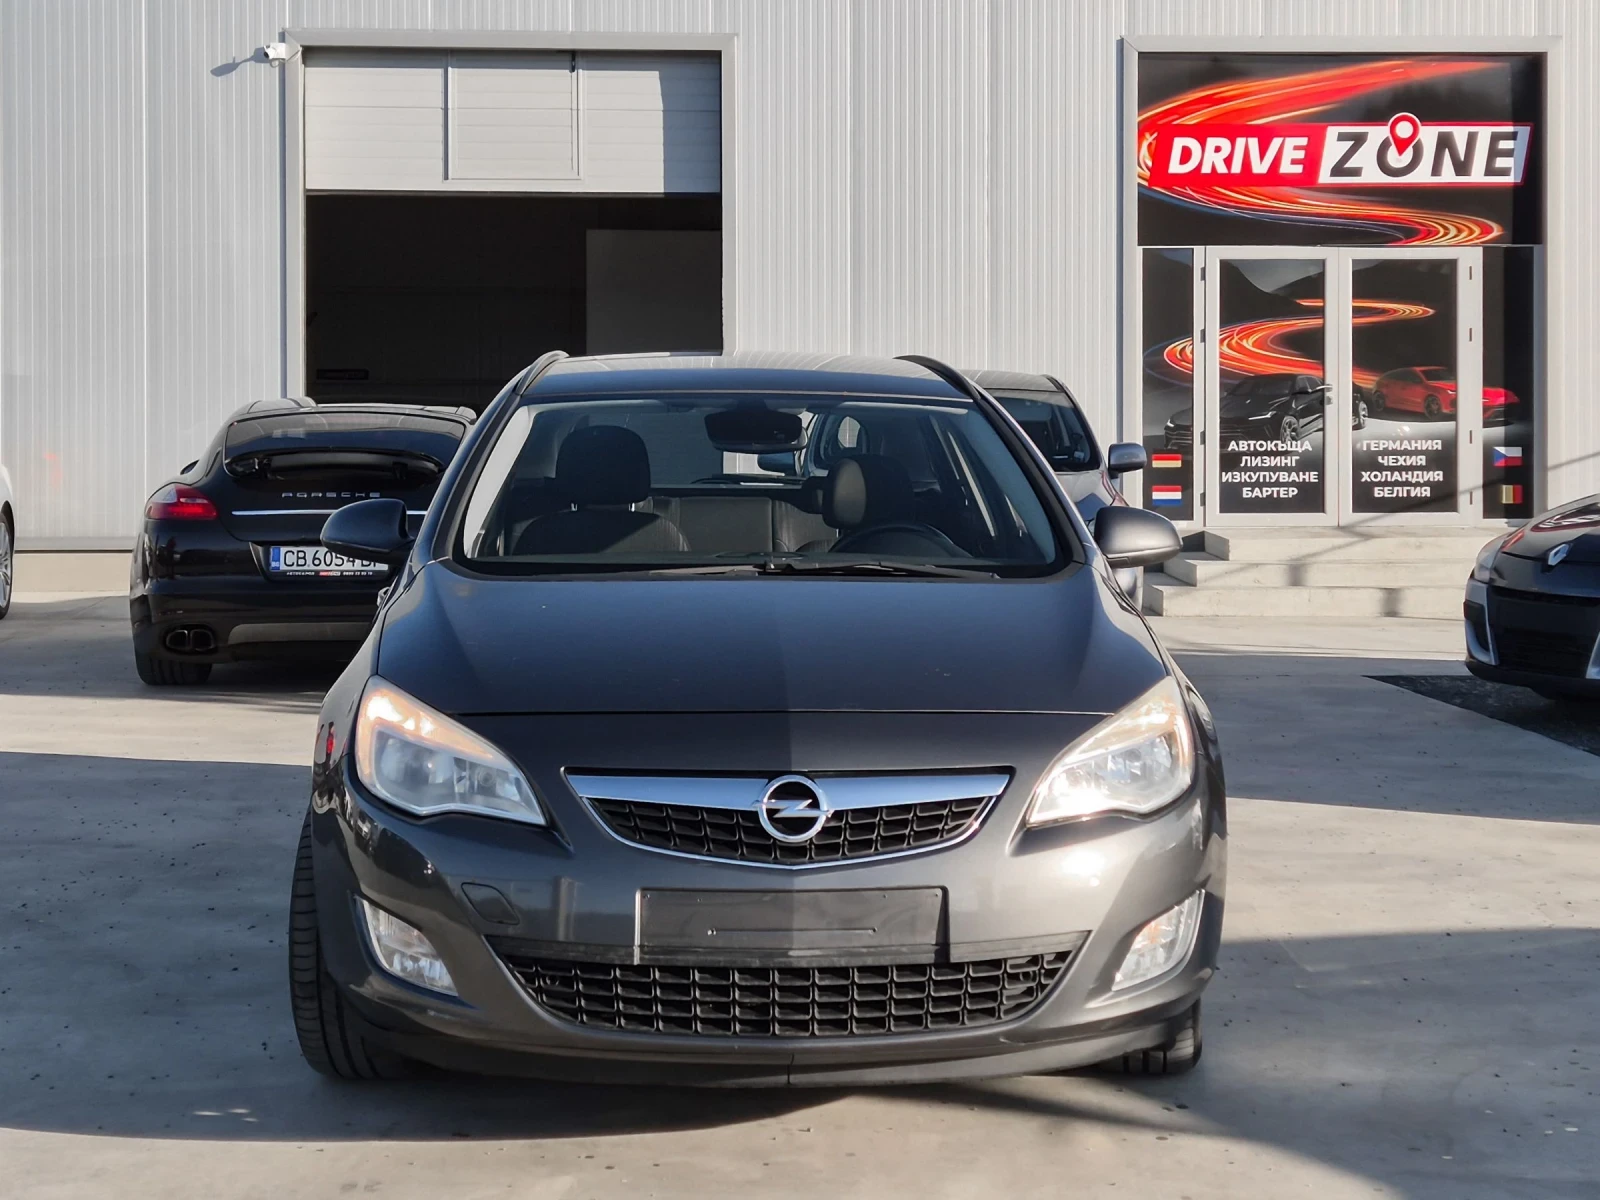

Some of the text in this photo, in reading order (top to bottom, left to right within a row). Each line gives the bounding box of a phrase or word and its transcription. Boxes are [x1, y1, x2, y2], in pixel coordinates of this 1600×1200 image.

[1167, 130, 1519, 178] DRIVE ZONE
[1227, 440, 1313, 453] АВТОКЪЩА
[1362, 439, 1442, 451] ГЕРМАНИЯ
[1240, 455, 1300, 467] ЛИЗИНГ
[1377, 455, 1427, 466] ЧЕХИЯ
[1221, 471, 1319, 483] ИЗКУПУВАНЕ
[1360, 470, 1444, 483] ХОЛАНДИЯ
[1242, 487, 1299, 498] БАРТЕР
[1373, 486, 1431, 498] БЕЛГИЯ
